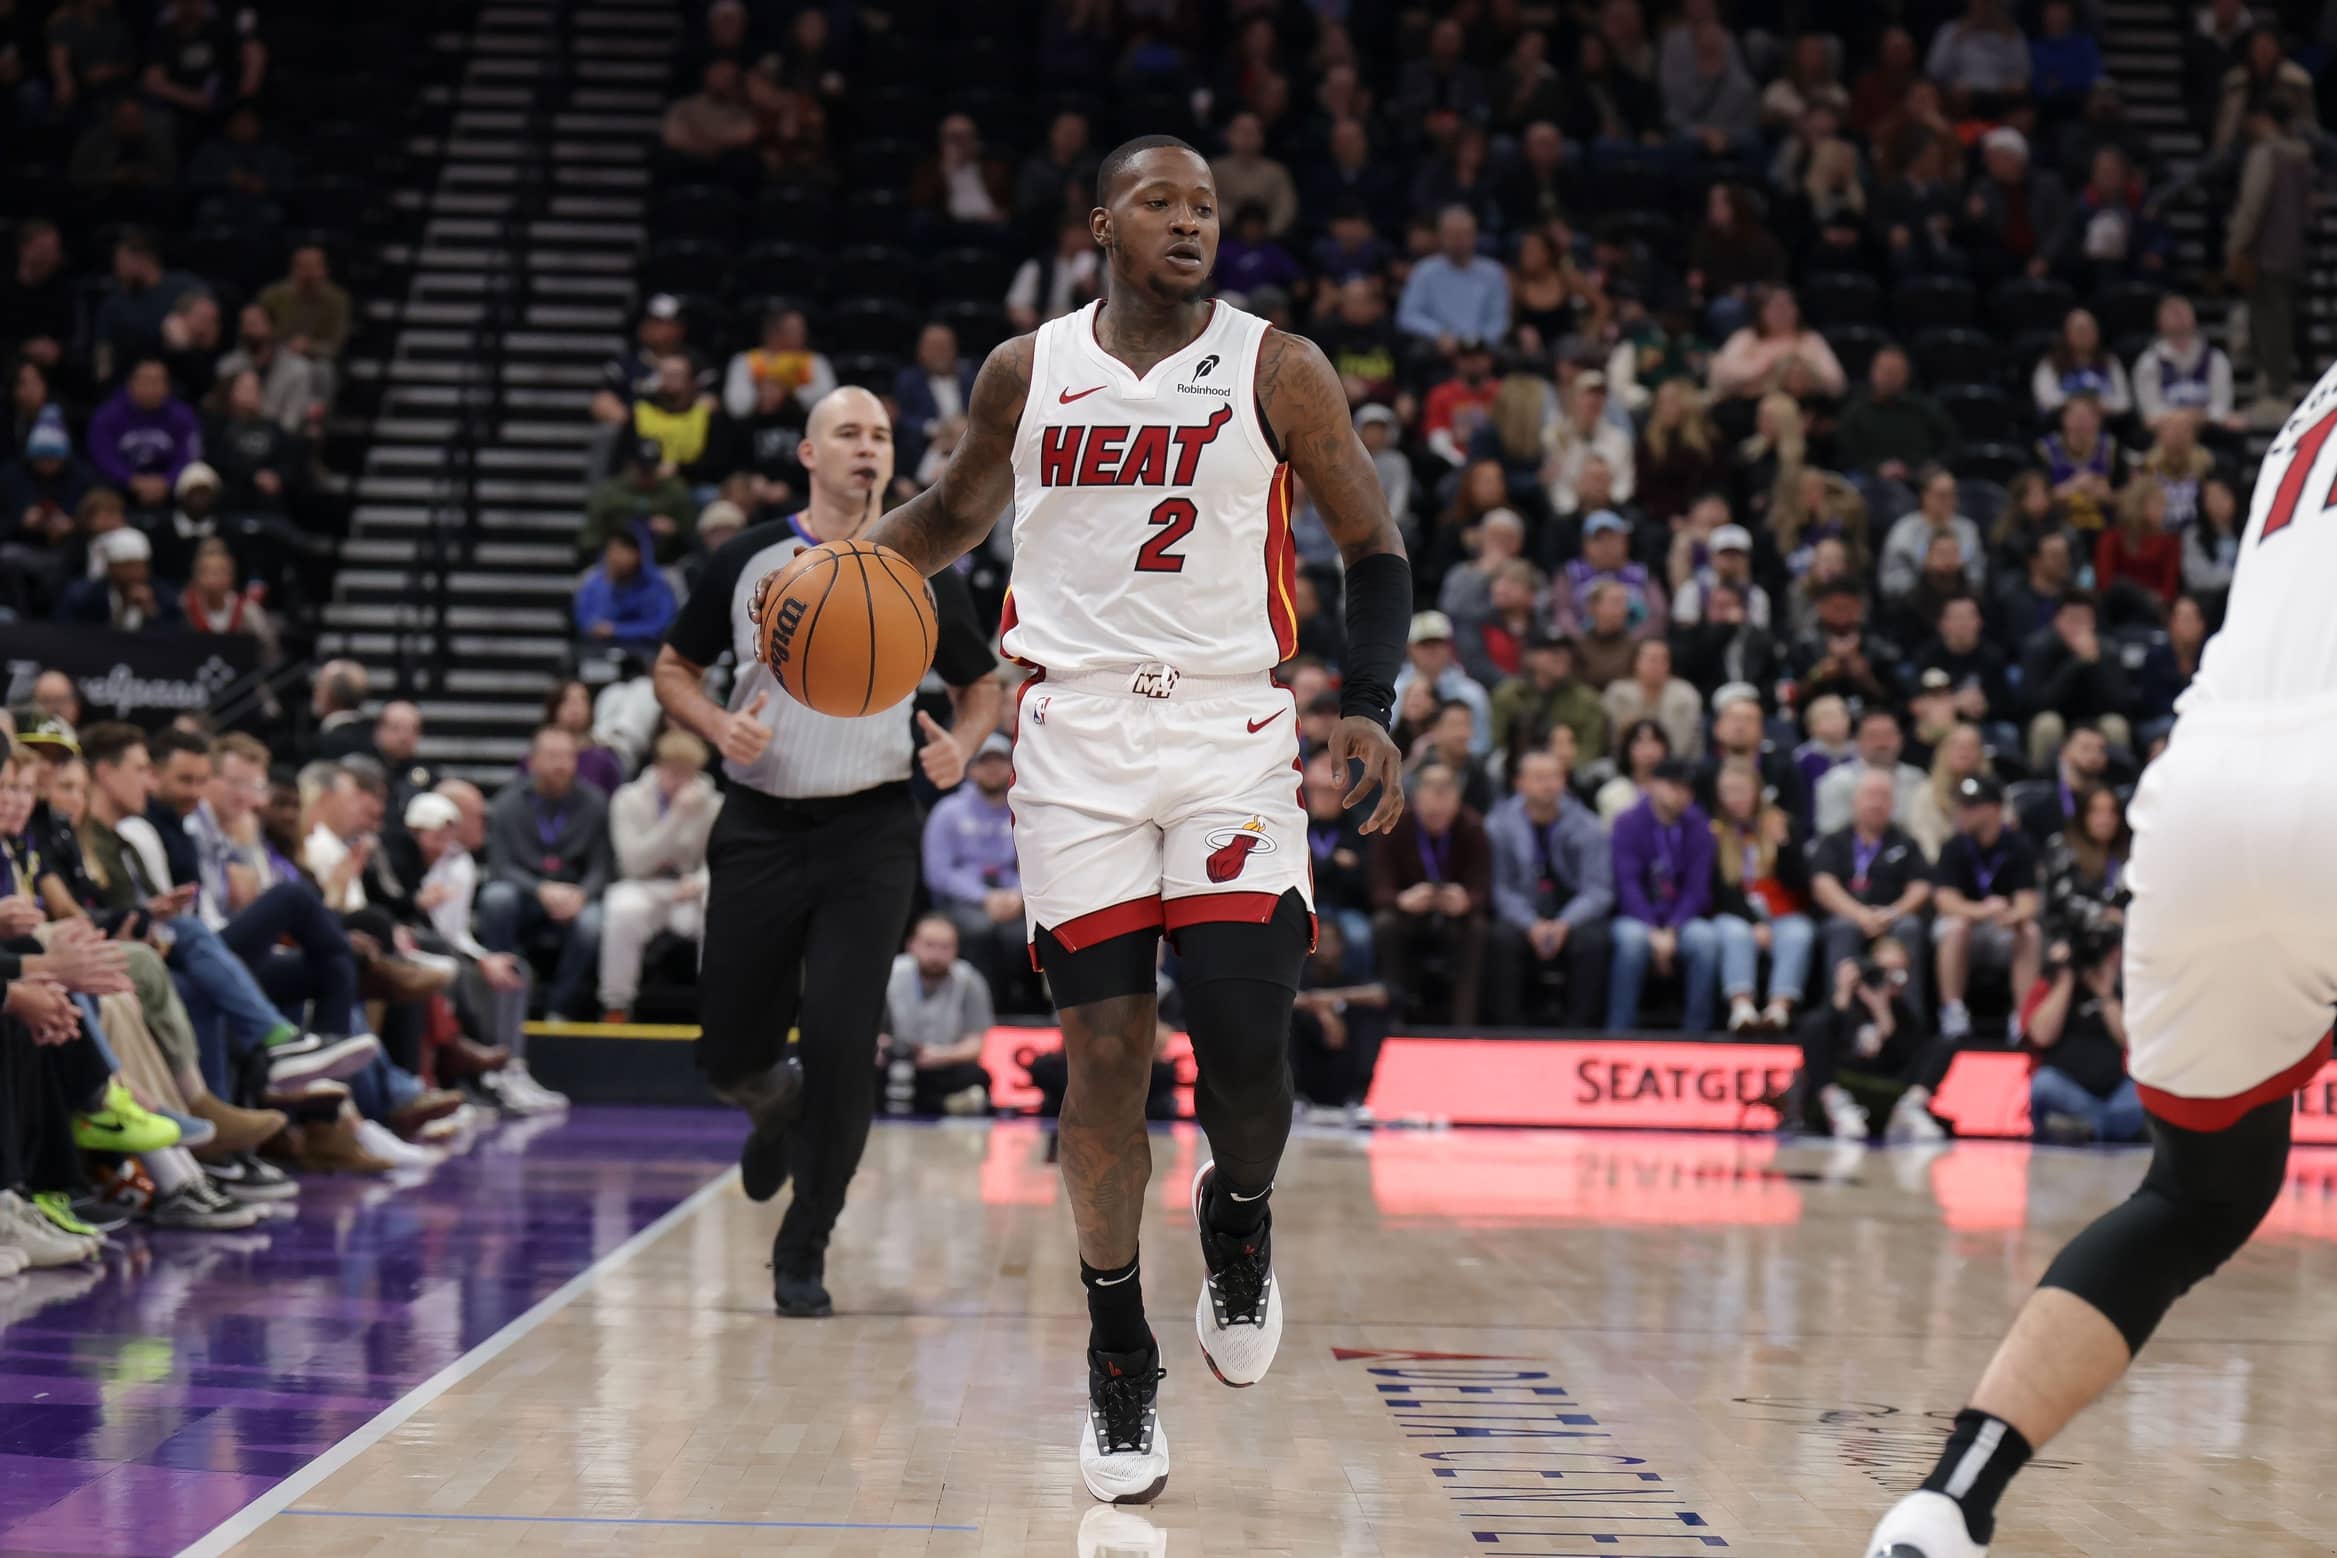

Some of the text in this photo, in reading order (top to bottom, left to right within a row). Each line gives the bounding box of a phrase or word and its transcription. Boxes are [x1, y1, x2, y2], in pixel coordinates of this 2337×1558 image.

[1177, 383, 1231, 397] Robinhood
[1041, 402, 1232, 487] HEAT
[1134, 497, 1198, 573] 2
[1577, 1059, 1792, 1104] SEATGEE
[1367, 1368, 1738, 1558] DELTA CENTE
